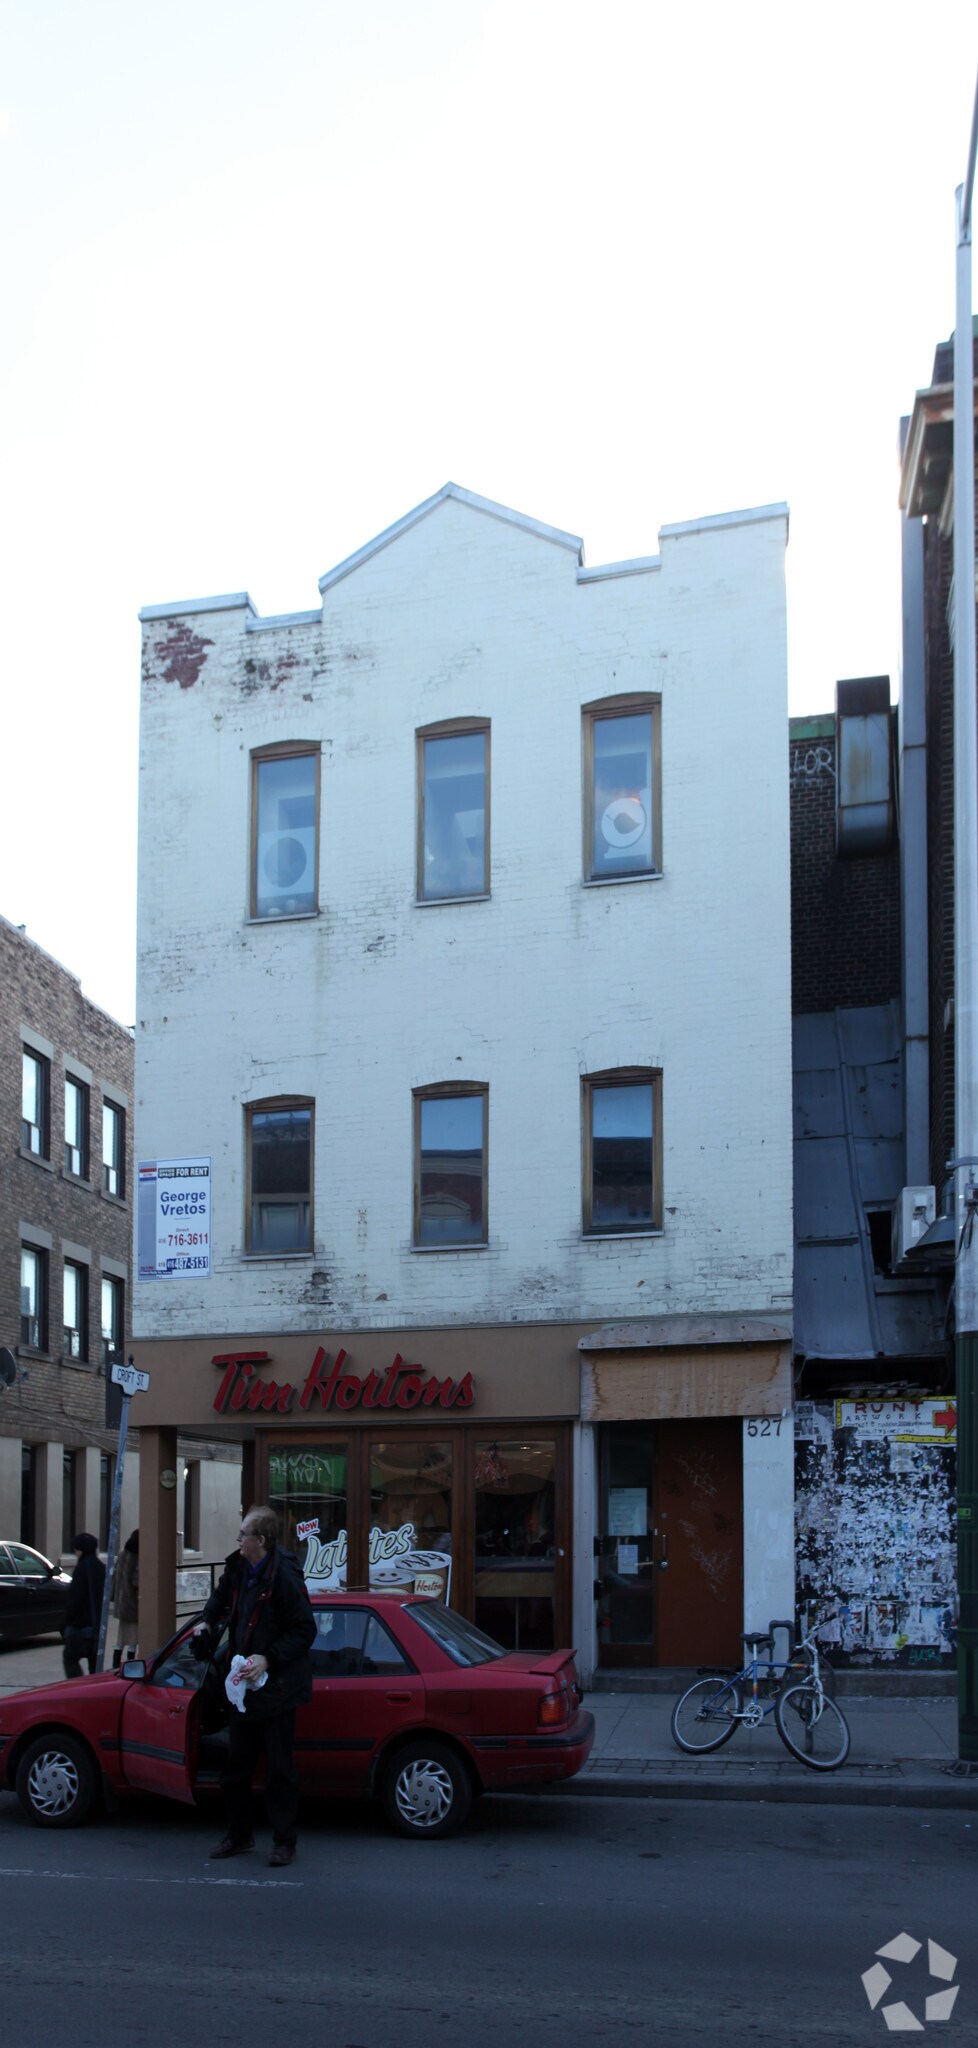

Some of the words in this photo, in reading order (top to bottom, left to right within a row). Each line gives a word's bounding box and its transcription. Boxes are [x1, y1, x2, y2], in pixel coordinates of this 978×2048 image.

[175, 1168, 189, 1176] FOR
[190, 1167, 208, 1176] RENT
[160, 1191, 206, 1203] George
[161, 1204, 206, 1216] Vretos
[168, 1233, 208, 1246] 716-3611
[117, 1368, 135, 1384] CROFT
[211, 1351, 294, 1414] Tim
[300, 1346, 475, 1410] Hortons
[855, 1400, 924, 1414] RUNT
[747, 1418, 782, 1437] 527
[297, 1521, 318, 1534] New
[304, 1525, 412, 1580] Lattes
